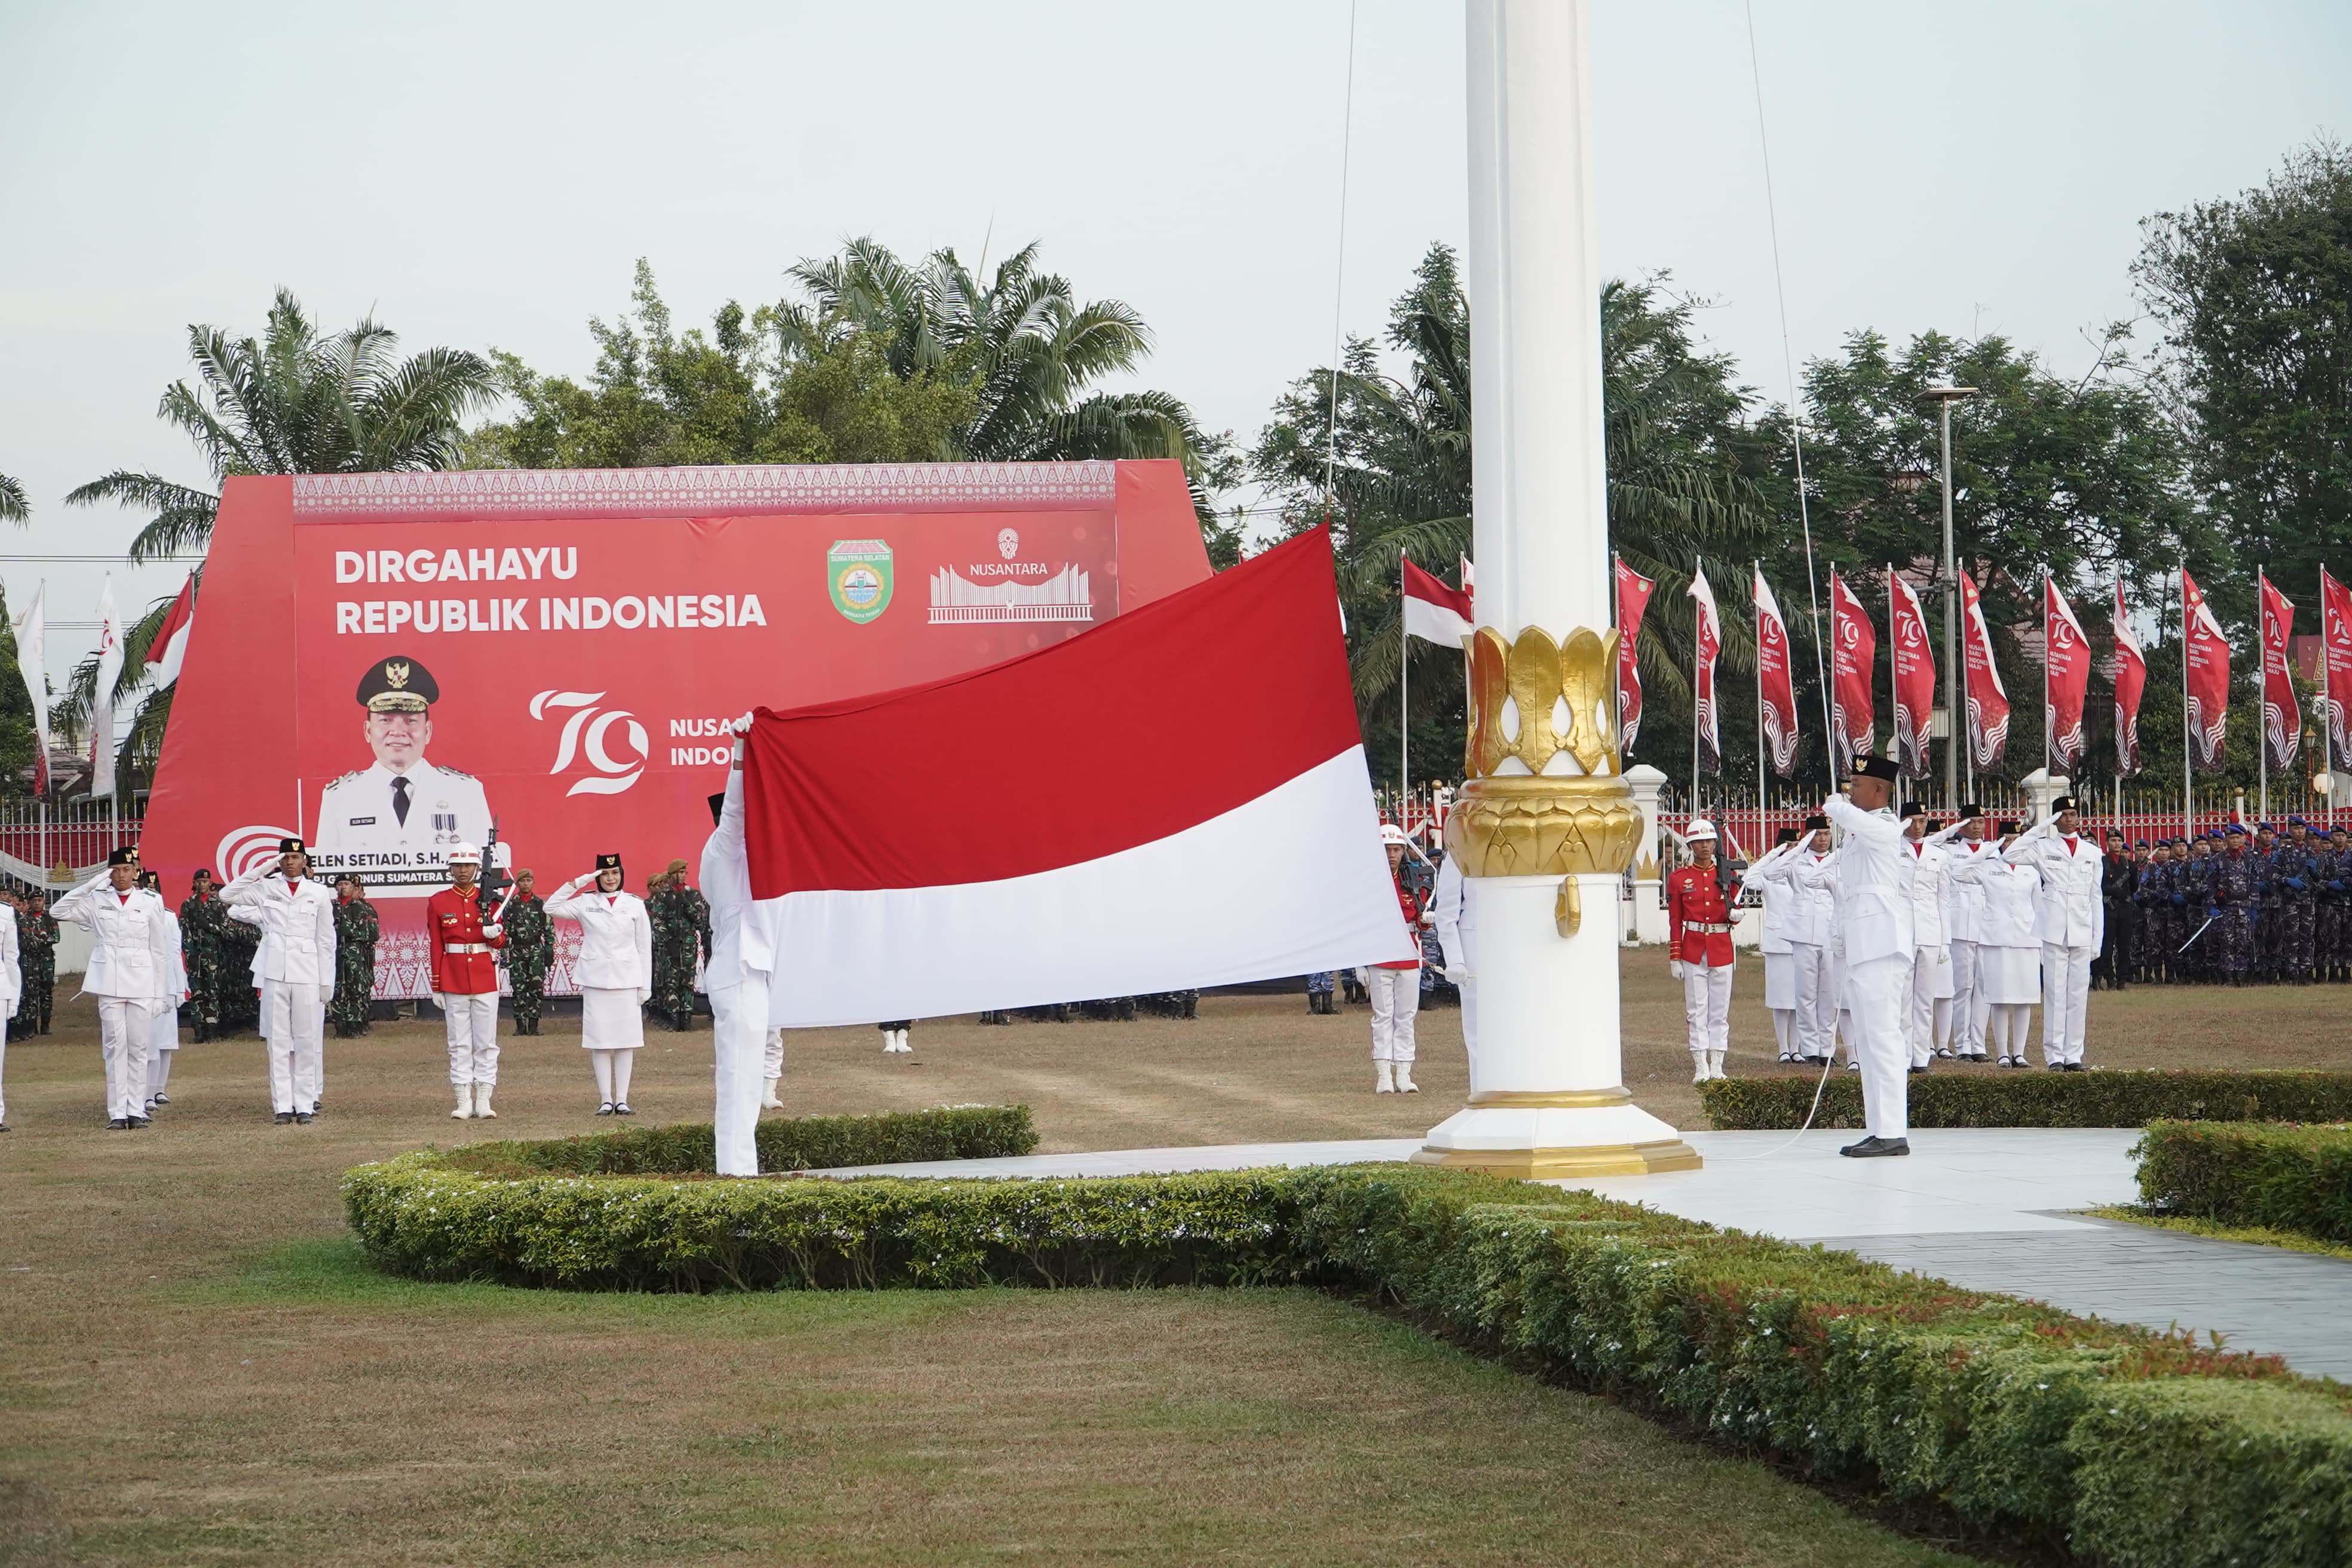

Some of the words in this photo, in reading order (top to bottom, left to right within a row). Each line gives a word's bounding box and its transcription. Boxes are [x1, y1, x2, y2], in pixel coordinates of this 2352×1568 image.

[336, 547, 577, 583] DIRGAHAYU
[970, 564, 1047, 575] NUSANTARA
[337, 599, 529, 633] REPUBLIK
[541, 595, 767, 629] INDONESIA
[310, 855, 344, 867] ELEN
[349, 853, 411, 866] SETIADI,
[387, 872, 443, 883] SUMATERA
